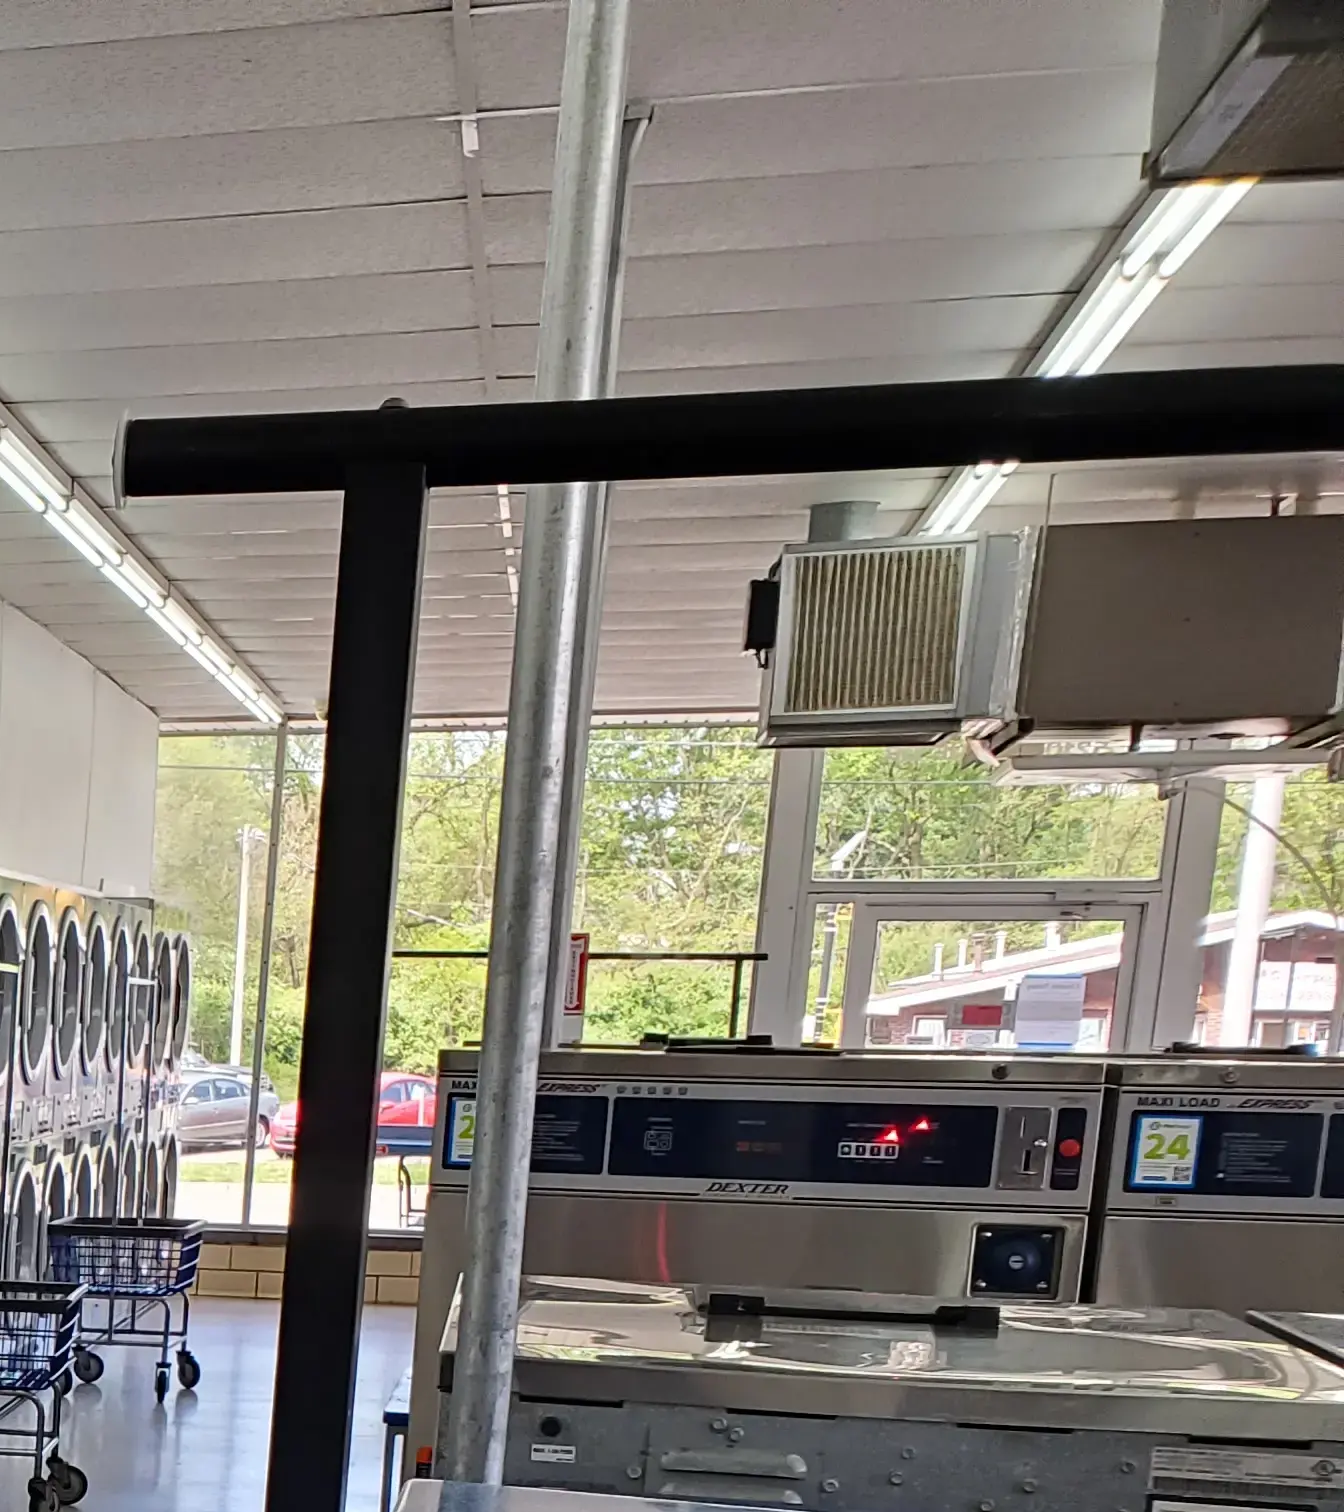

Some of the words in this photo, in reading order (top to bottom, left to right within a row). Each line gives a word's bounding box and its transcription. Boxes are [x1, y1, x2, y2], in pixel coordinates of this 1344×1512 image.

[452, 1080, 477, 1091] MAX
[536, 1083, 601, 1094] EXPRESS
[1137, 1096, 1173, 1107] MAXI
[1179, 1097, 1221, 1108] LOAD
[1236, 1098, 1315, 1110] EXPRESS
[1143, 1133, 1191, 1160] 24
[705, 1182, 790, 1194] DEXTER
